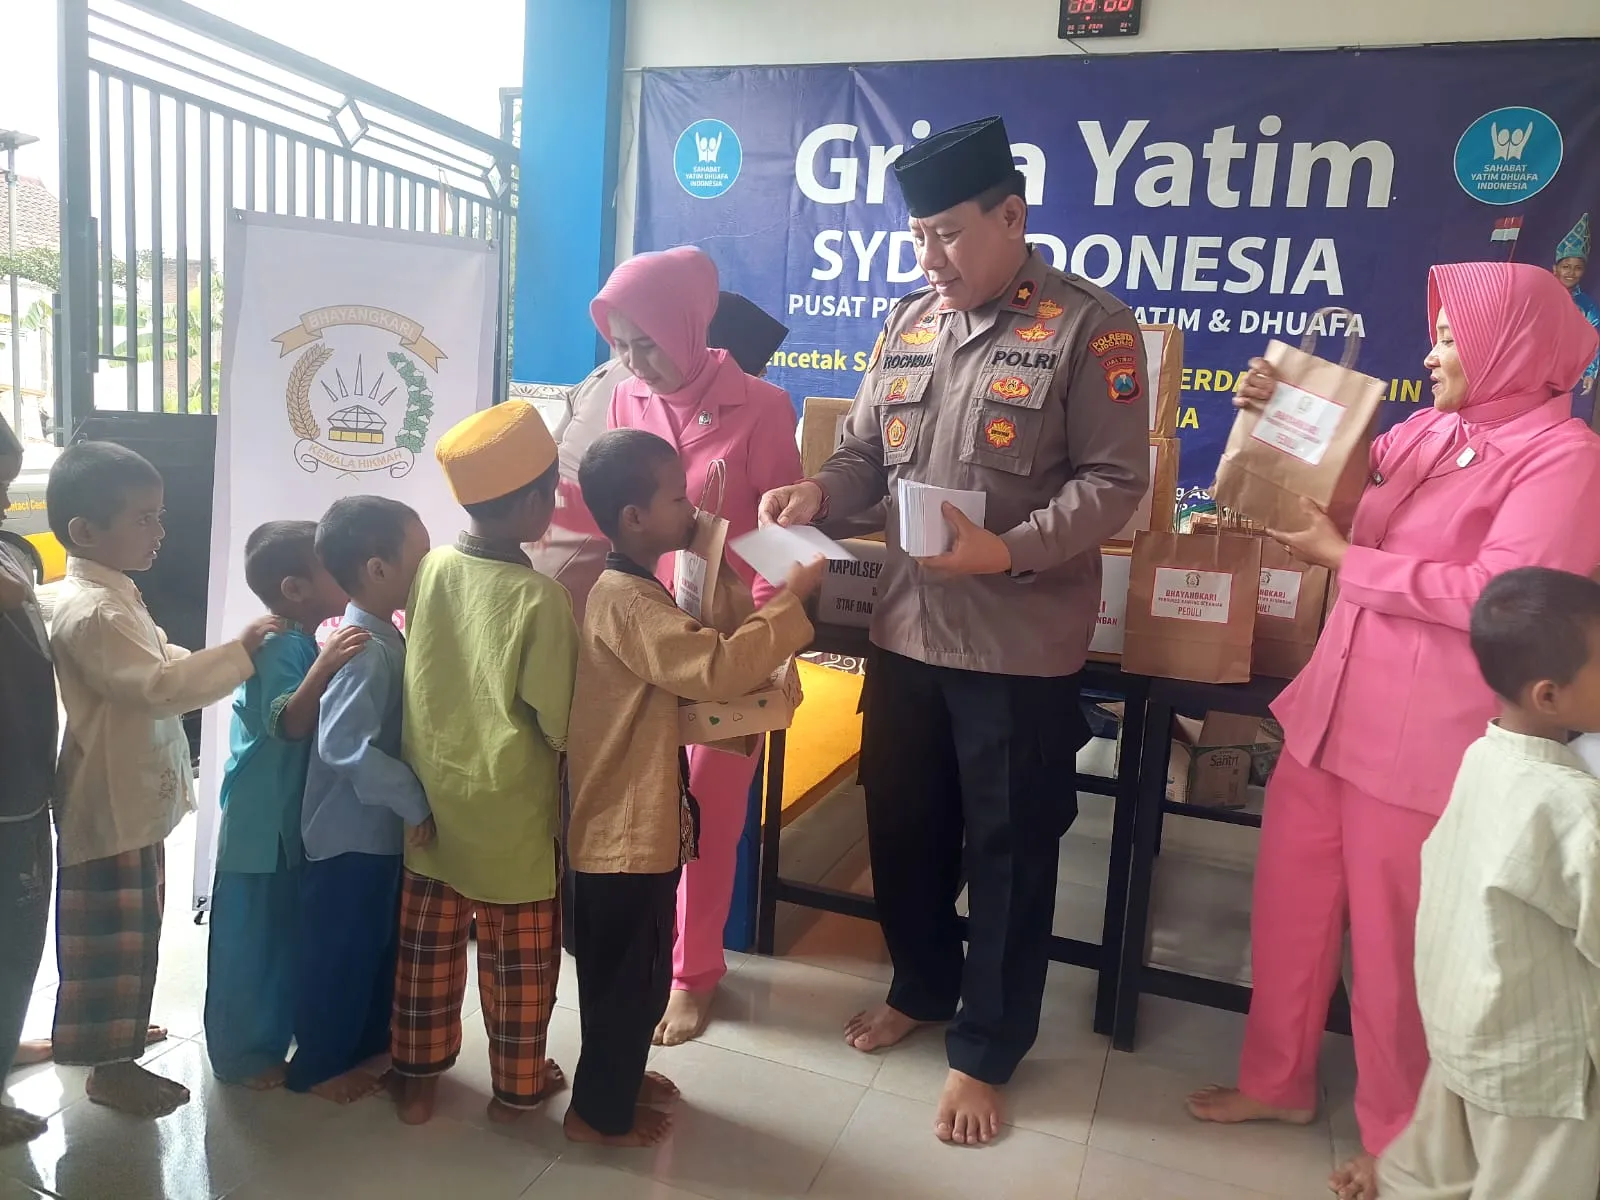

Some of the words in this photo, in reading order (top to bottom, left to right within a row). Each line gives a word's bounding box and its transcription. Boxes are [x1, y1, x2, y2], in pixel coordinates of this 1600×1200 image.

[795, 120, 1046, 206] Gra
[1078, 115, 1395, 208] Yatim
[1484, 164, 1528, 172] SAHABAT
[1471, 173, 1499, 181] YATIM
[1501, 173, 1538, 181] DHUAFA
[1477, 182, 1528, 190] INDONESIA
[1024, 233, 1345, 297] DONESIA
[309, 308, 416, 340] BHAYANGKARI
[788, 294, 866, 318] PUSAT
[1131, 306, 1200, 332] ATIM
[1209, 308, 1231, 333] &
[1239, 310, 1366, 338] DHUAFA
[766, 349, 848, 372] ncetak
[992, 350, 1056, 370] POLRI
[308, 443, 356, 469] KEMALA
[357, 451, 403, 469] HIKMAH
[1165, 589, 1217, 601] BHAYANGKARI
[835, 597, 855, 612] STAF
[856, 600, 874, 615] DAN
[1177, 606, 1202, 617] PEDULI
